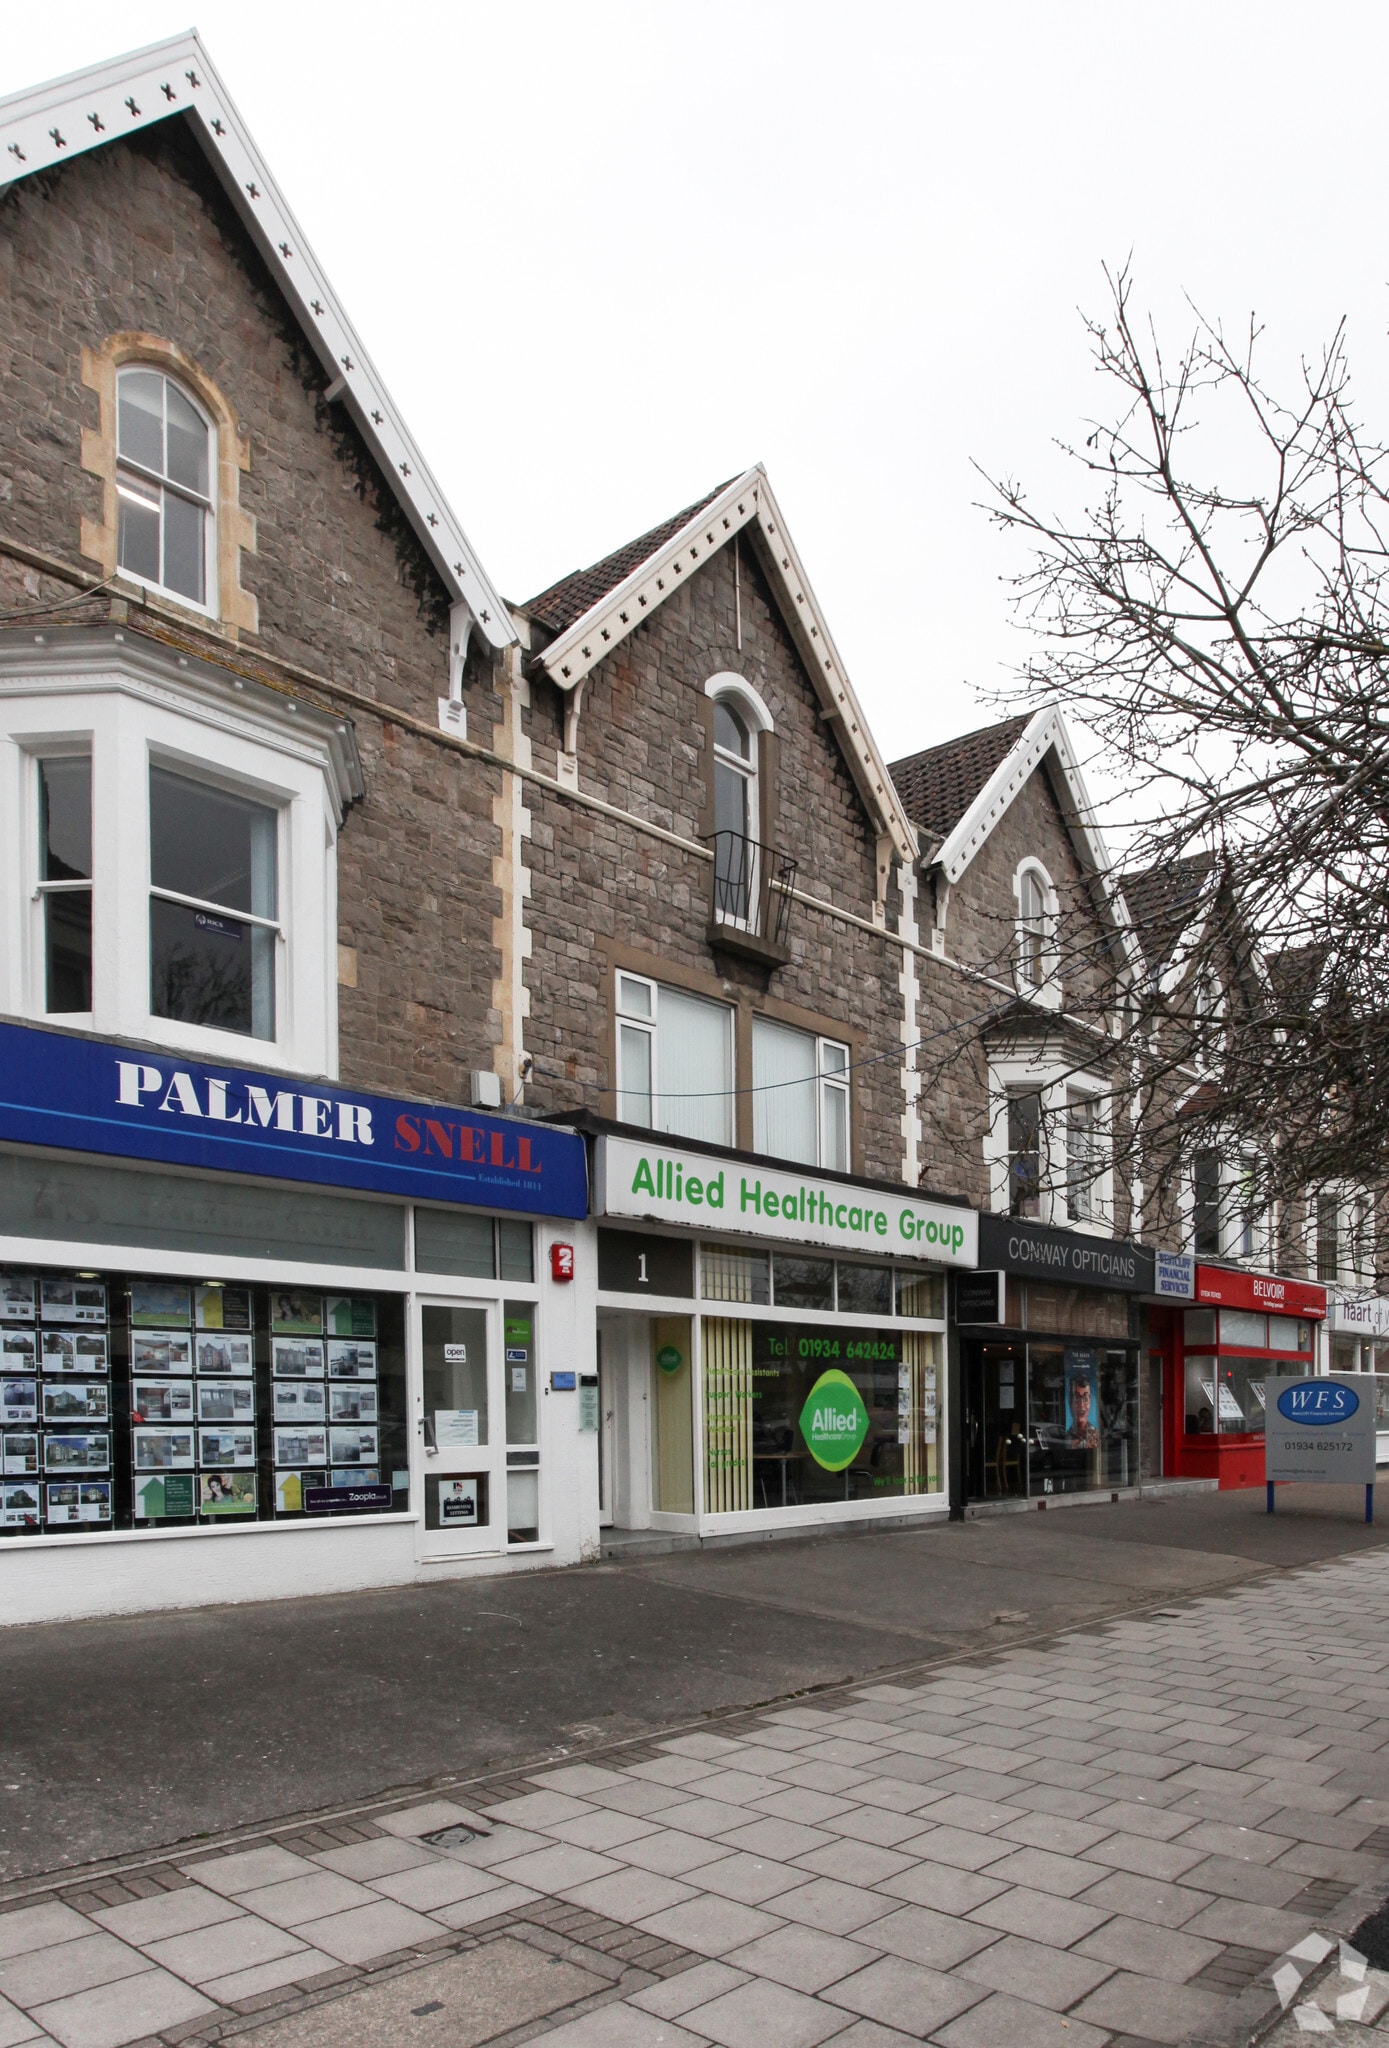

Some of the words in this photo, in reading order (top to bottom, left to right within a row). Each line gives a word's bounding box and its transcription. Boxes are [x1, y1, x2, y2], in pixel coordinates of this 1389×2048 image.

[115, 1060, 375, 1145] PALMER
[394, 1114, 543, 1173] SNELL
[479, 1173, 520, 1188] Established
[631, 1157, 724, 1209] Allied
[740, 1177, 888, 1237] Healthcare
[899, 1209, 965, 1254] Group
[558, 1248, 572, 1267] 2
[1008, 1237, 1069, 1267] CONWAY
[1072, 1248, 1136, 1278] OPTICIANS
[637, 1253, 649, 1283] 1
[1158, 1266, 1191, 1281] FINANCIAL
[963, 1289, 992, 1297] CONWAY
[1160, 1280, 1189, 1294] SERVICES
[960, 1299, 995, 1307] OPTICIANS
[446, 1348, 465, 1357] open
[799, 1338, 840, 1357] 01934
[846, 1341, 895, 1359] 642424
[812, 1408, 856, 1431] Allied
[1285, 1442, 1314, 1451] 01934
[1317, 1442, 1353, 1452] 625172
